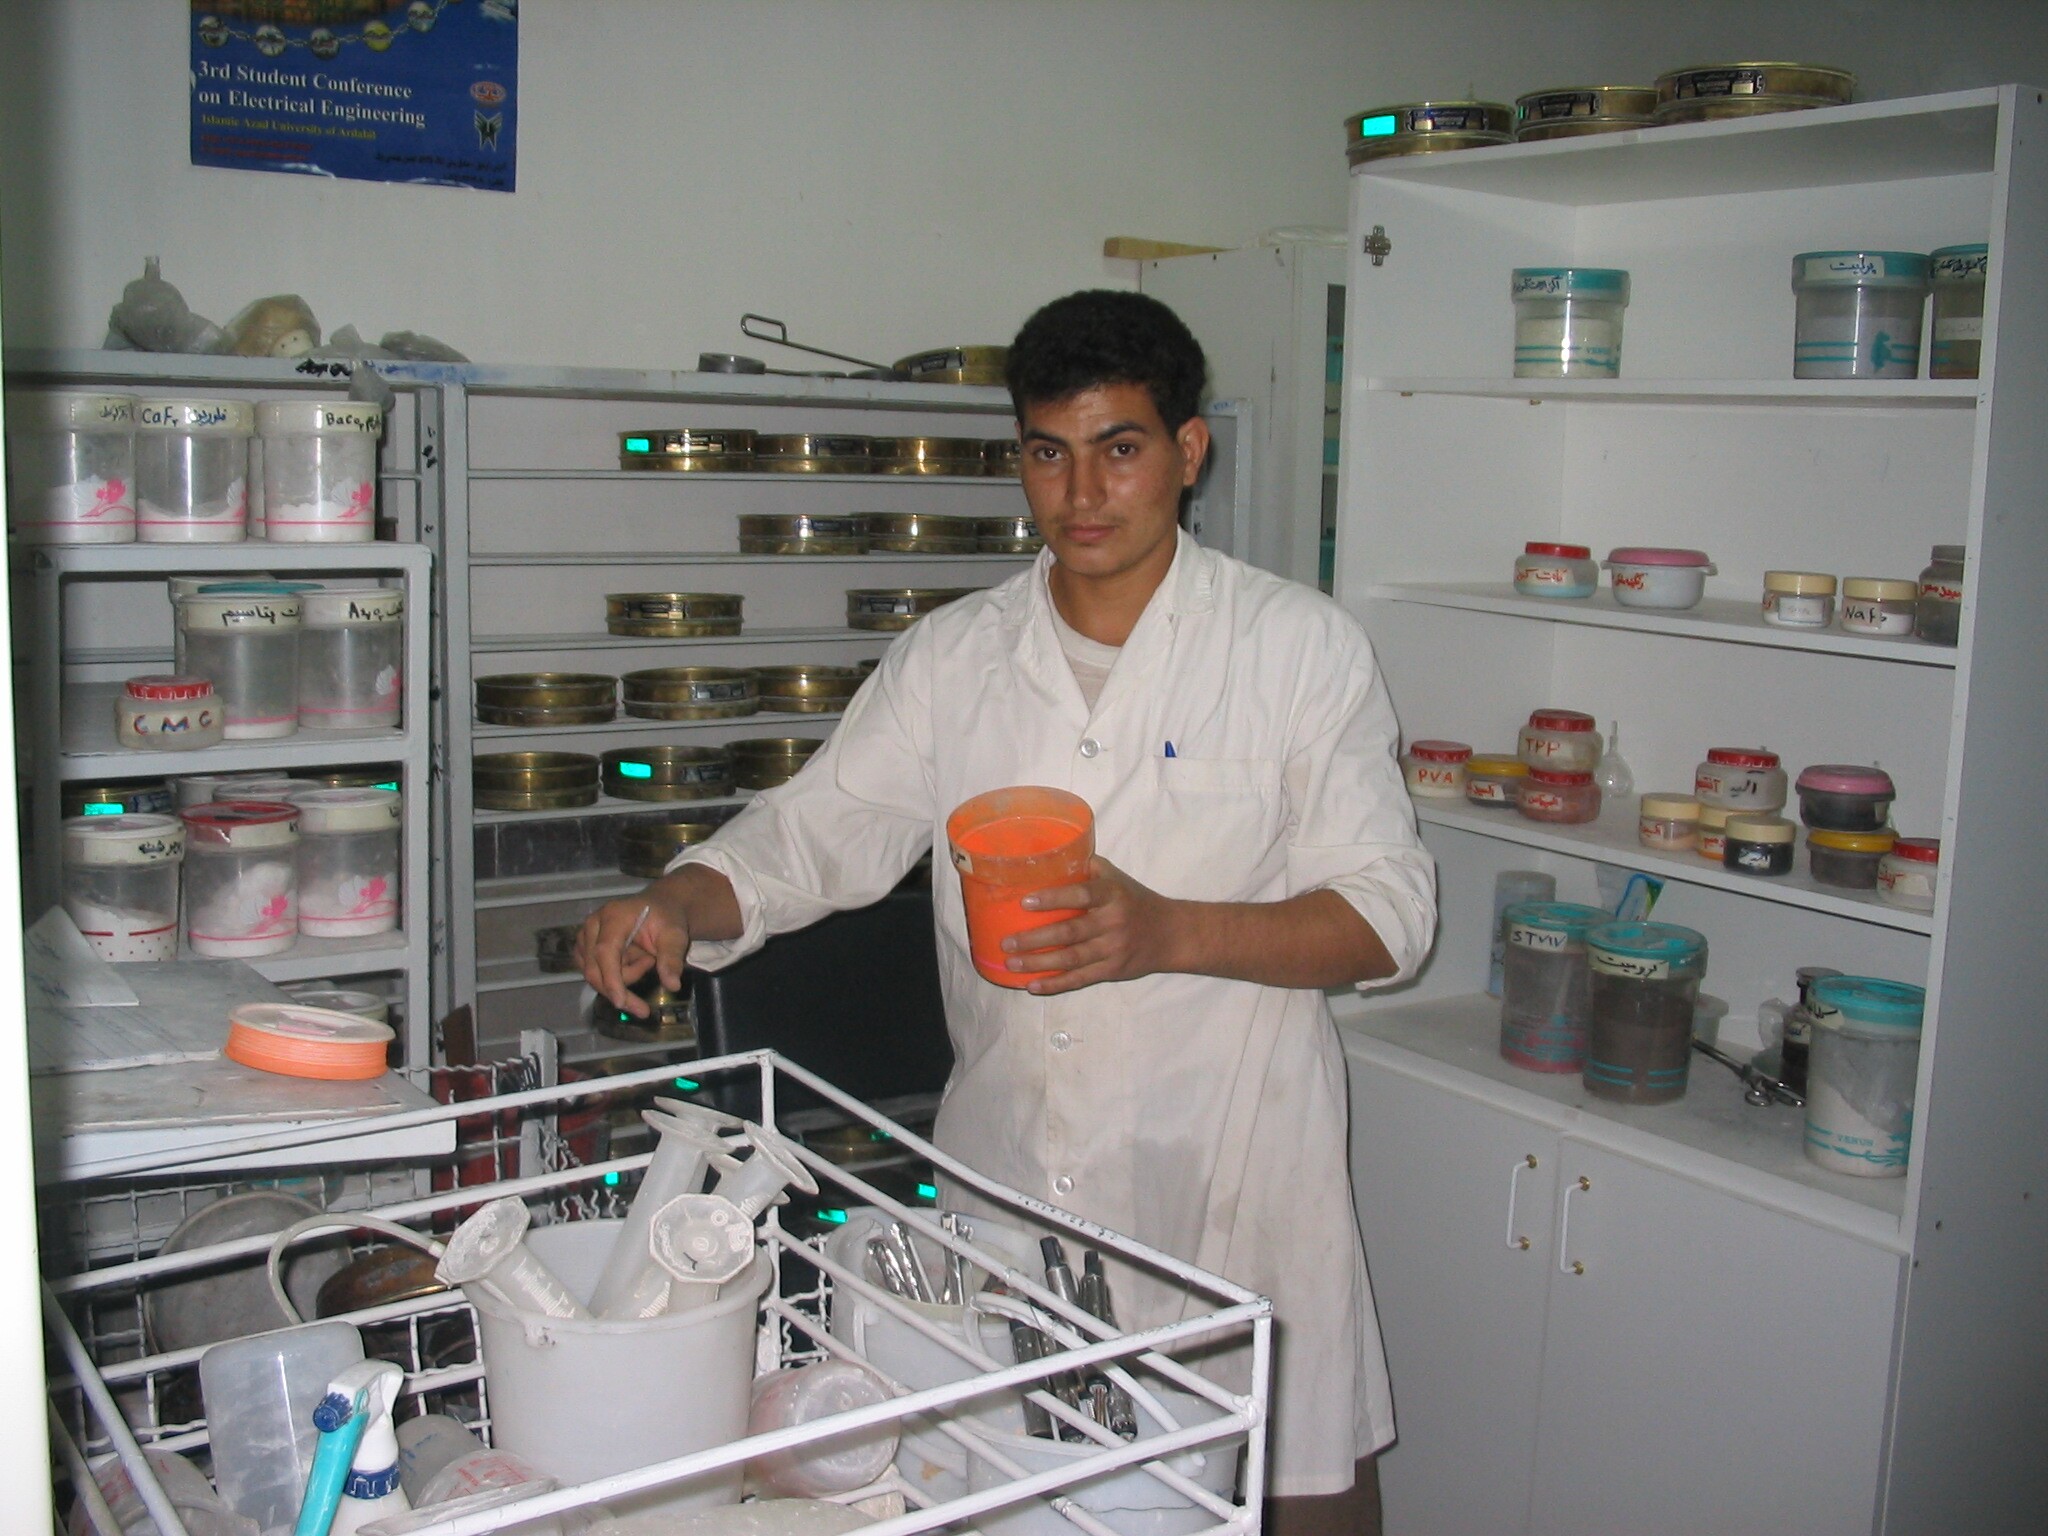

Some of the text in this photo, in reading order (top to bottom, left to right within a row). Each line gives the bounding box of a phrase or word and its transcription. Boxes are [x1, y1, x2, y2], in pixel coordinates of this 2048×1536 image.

[199, 60, 413, 99] 3rd Student Conference
[198, 89, 427, 129] on Electrical Engineering
[202, 114, 239, 127] Islamic
[244, 117, 269, 130] Azad
[272, 119, 323, 135] University
[1525, 738, 1560, 757] TPP
[1418, 768, 1453, 784] PVA
